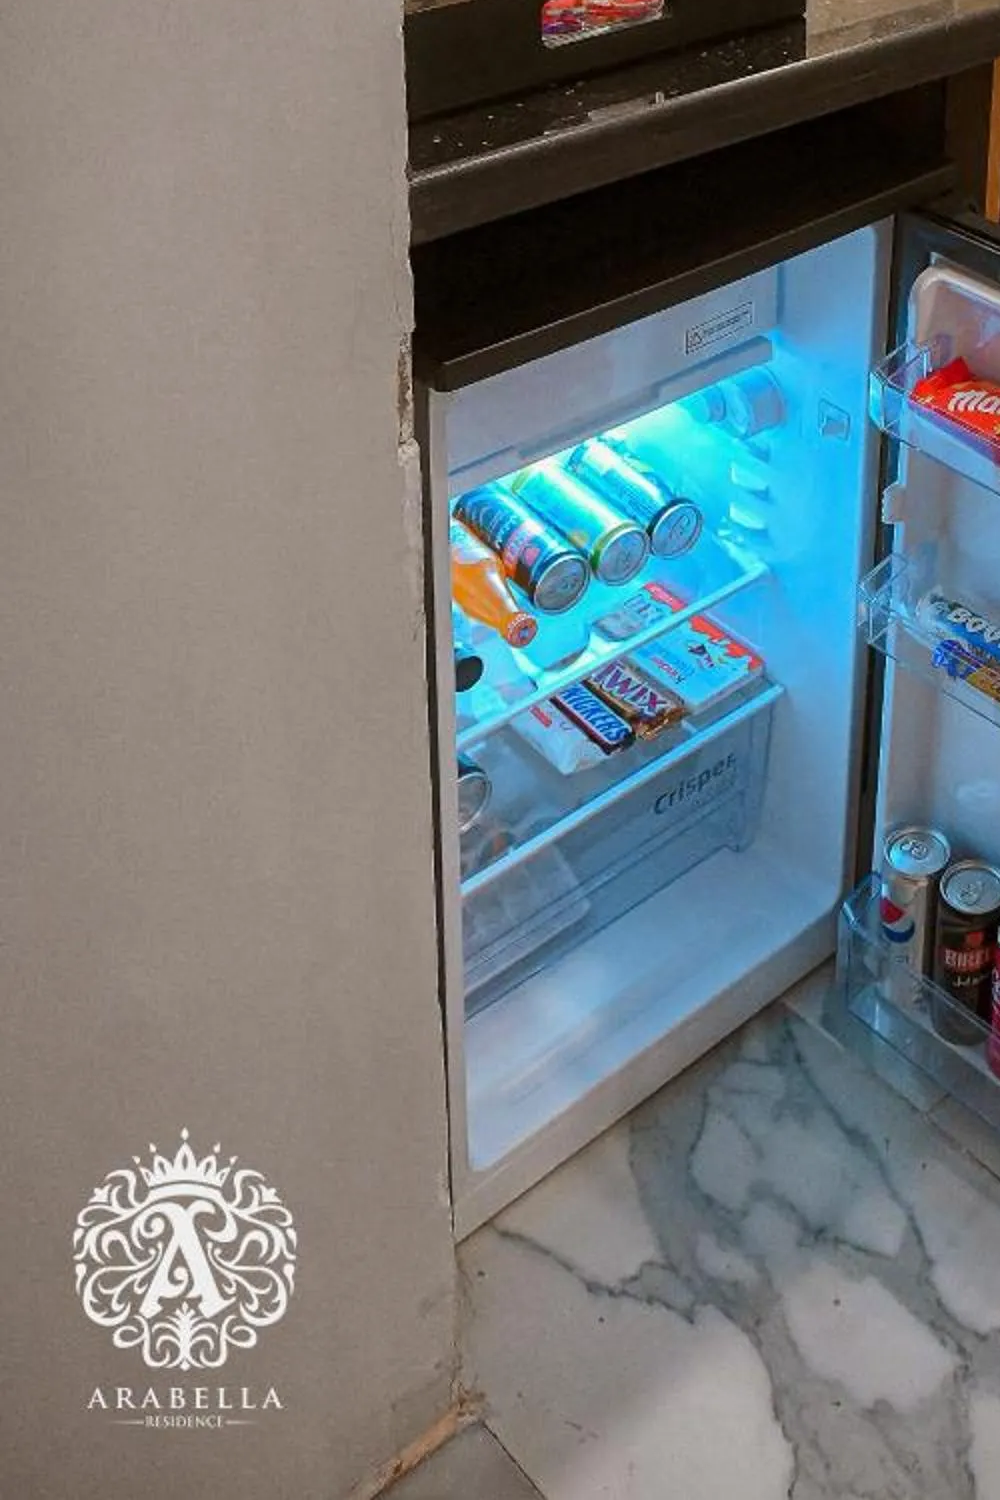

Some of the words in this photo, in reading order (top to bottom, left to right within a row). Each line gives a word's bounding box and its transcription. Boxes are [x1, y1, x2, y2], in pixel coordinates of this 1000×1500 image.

[560, 684, 630, 741] NICKERS
[591, 660, 668, 717] TWIX
[653, 753, 738, 815] Crisper
